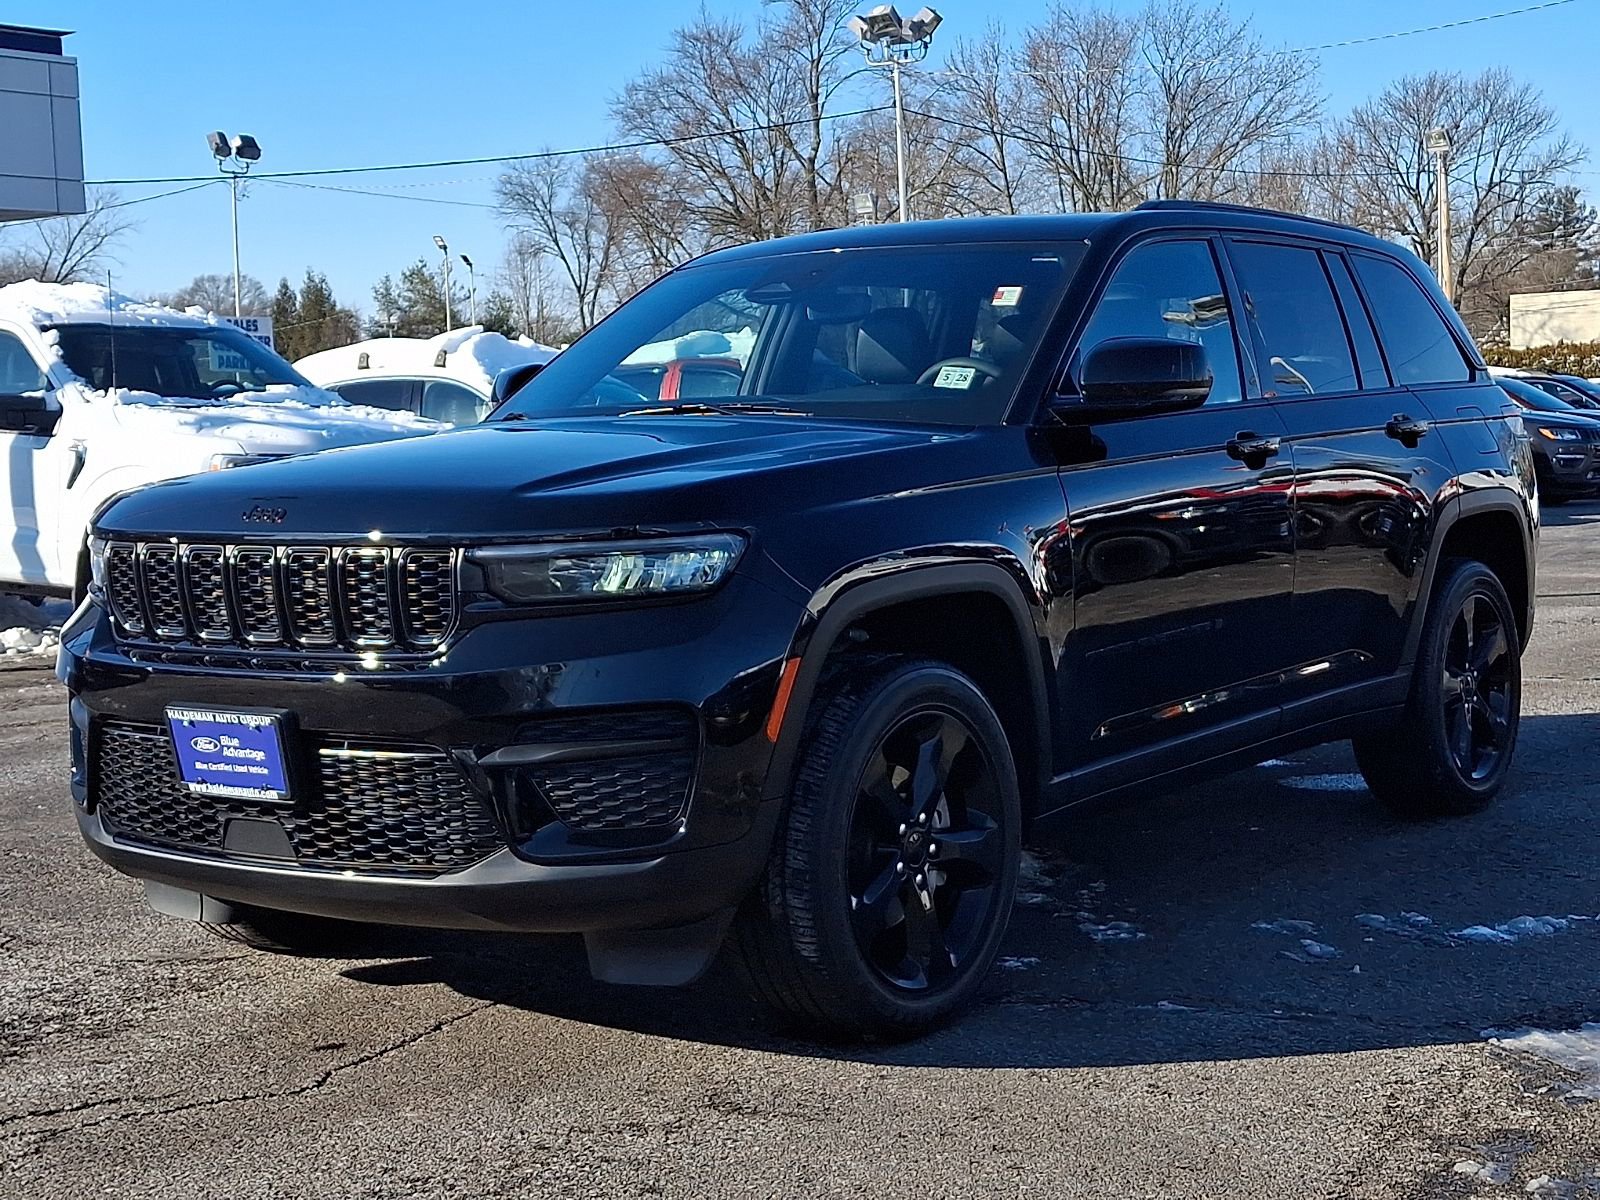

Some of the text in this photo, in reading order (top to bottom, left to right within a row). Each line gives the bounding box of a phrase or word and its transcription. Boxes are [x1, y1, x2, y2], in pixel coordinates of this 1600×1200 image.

[942, 372, 969, 382] 5 28
[167, 709, 271, 726] HALDEMAN AUTO GROUP
[220, 735, 240, 746] Blue
[223, 747, 266, 761] Advantage
[188, 783, 279, 799] www.haldemanauto.com
